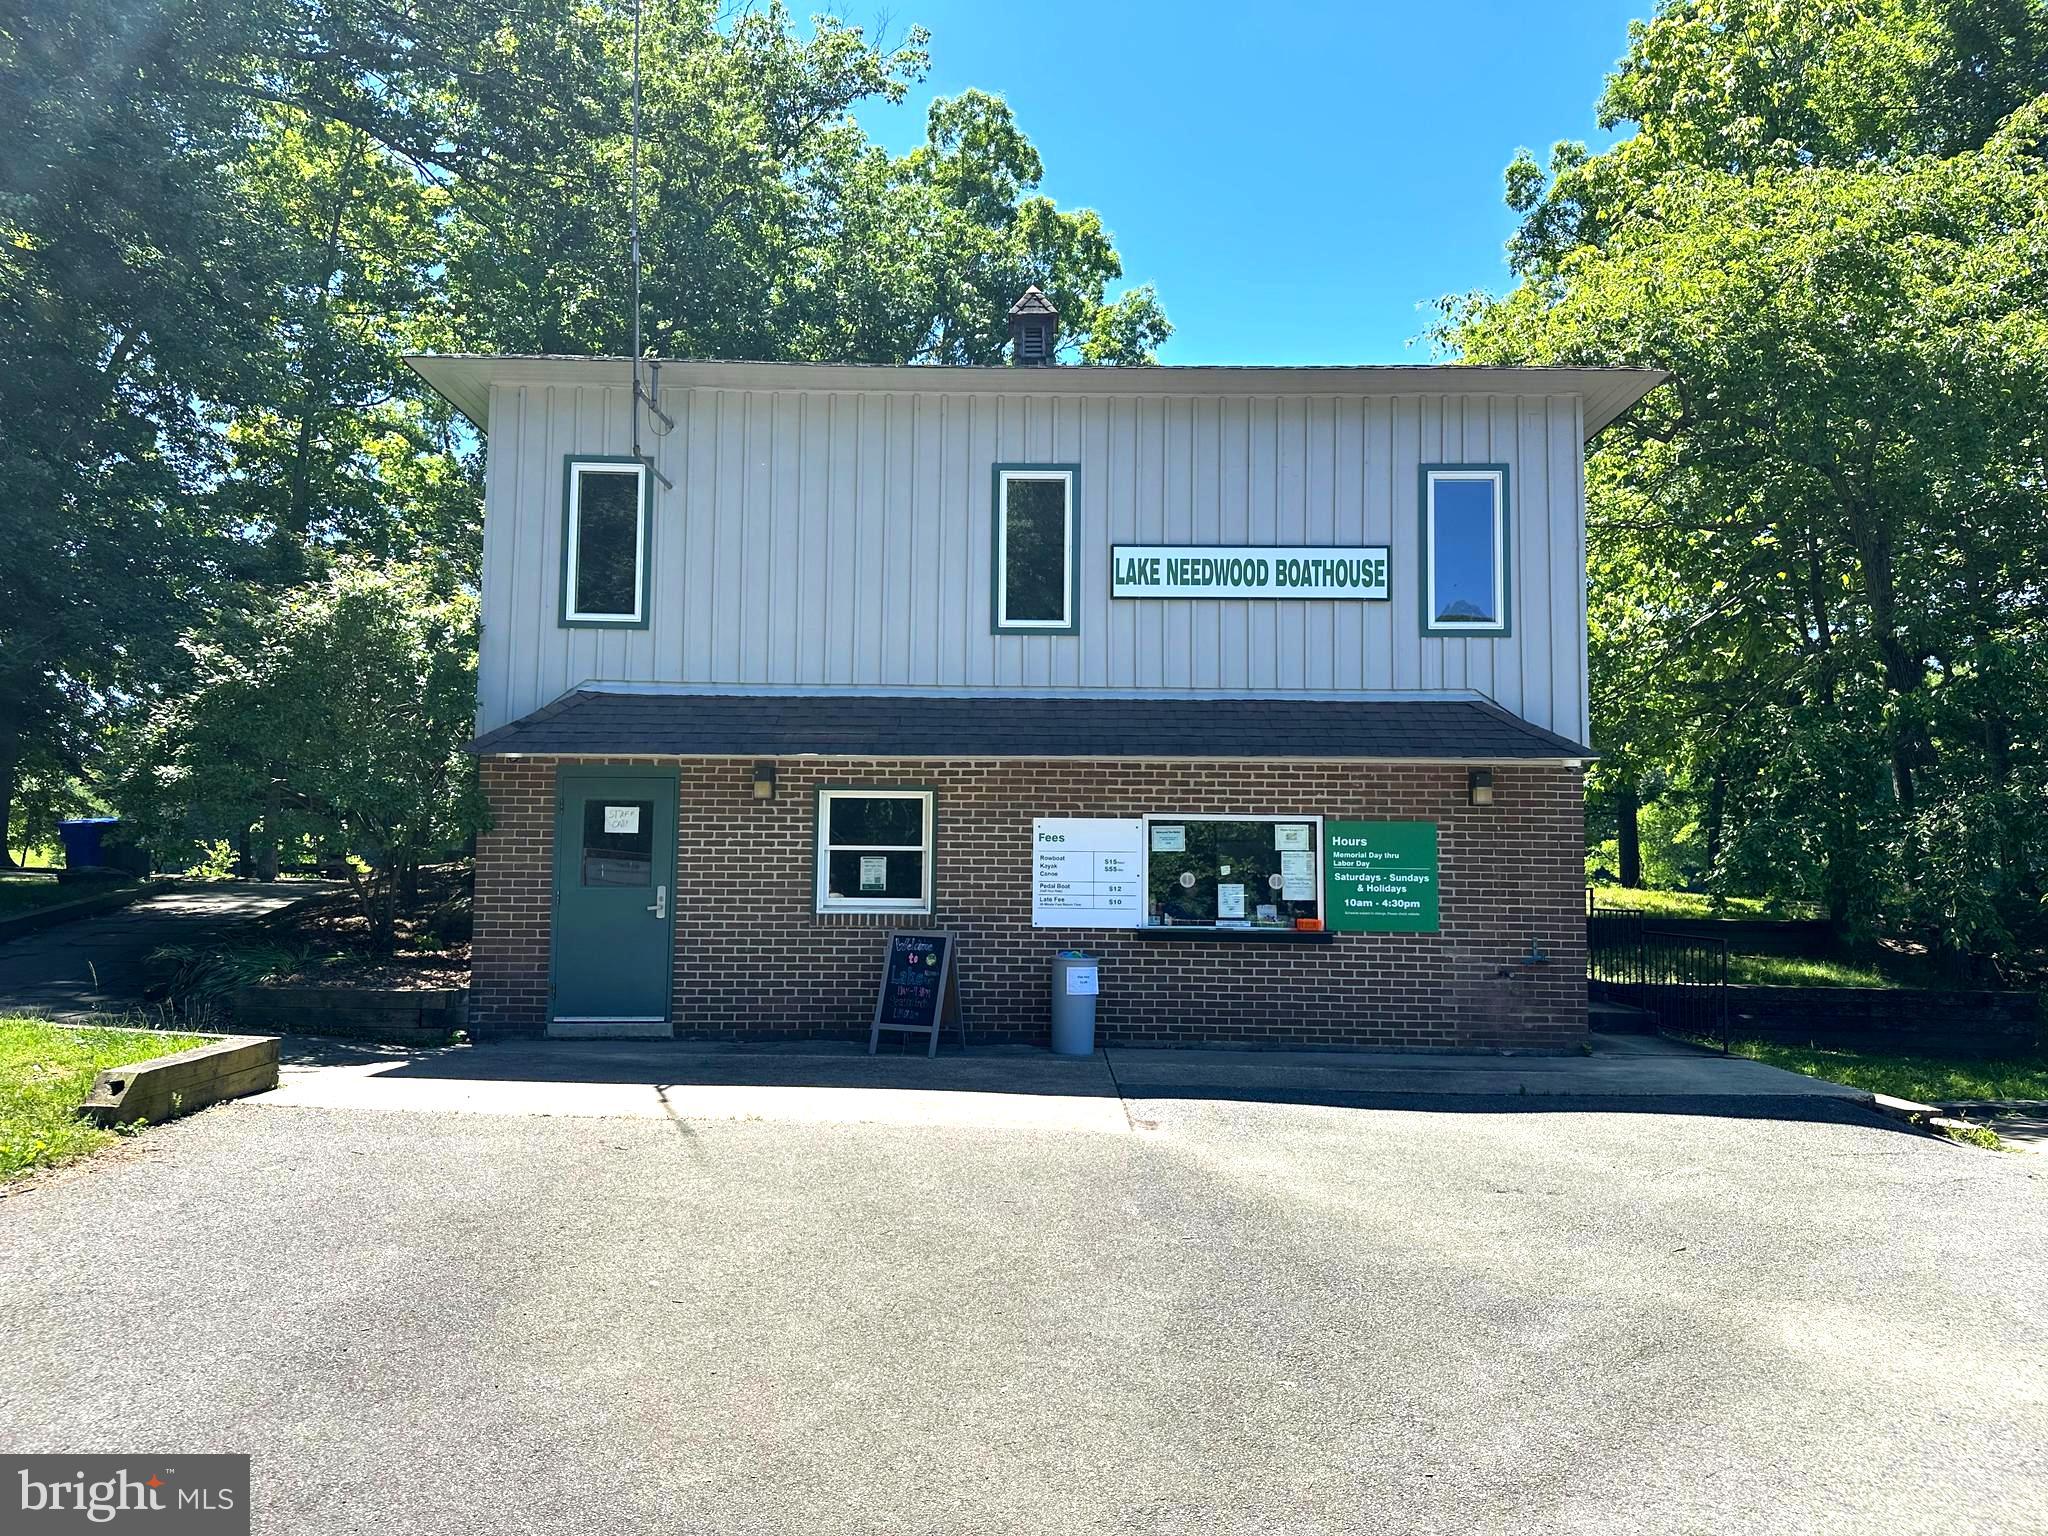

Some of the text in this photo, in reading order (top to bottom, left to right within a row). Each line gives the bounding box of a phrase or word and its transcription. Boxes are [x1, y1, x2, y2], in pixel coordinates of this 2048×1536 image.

[1115, 557, 1385, 588] LAKE NEEDWOOD BOATHOUSE
[1038, 832, 1065, 842] Fees
[1332, 836, 1367, 846] Hours
[1368, 852, 1382, 860] Day
[1356, 860, 1370, 868] Day
[1334, 872, 1381, 883] Saturdays
[1389, 873, 1430, 883] Sundays
[1356, 884, 1407, 894] & Holidays
[1344, 898, 1373, 907] 10am
[1381, 899, 1420, 909] 4:30pm
[895, 937, 933, 951] Welcome
[908, 952, 919, 964] to
